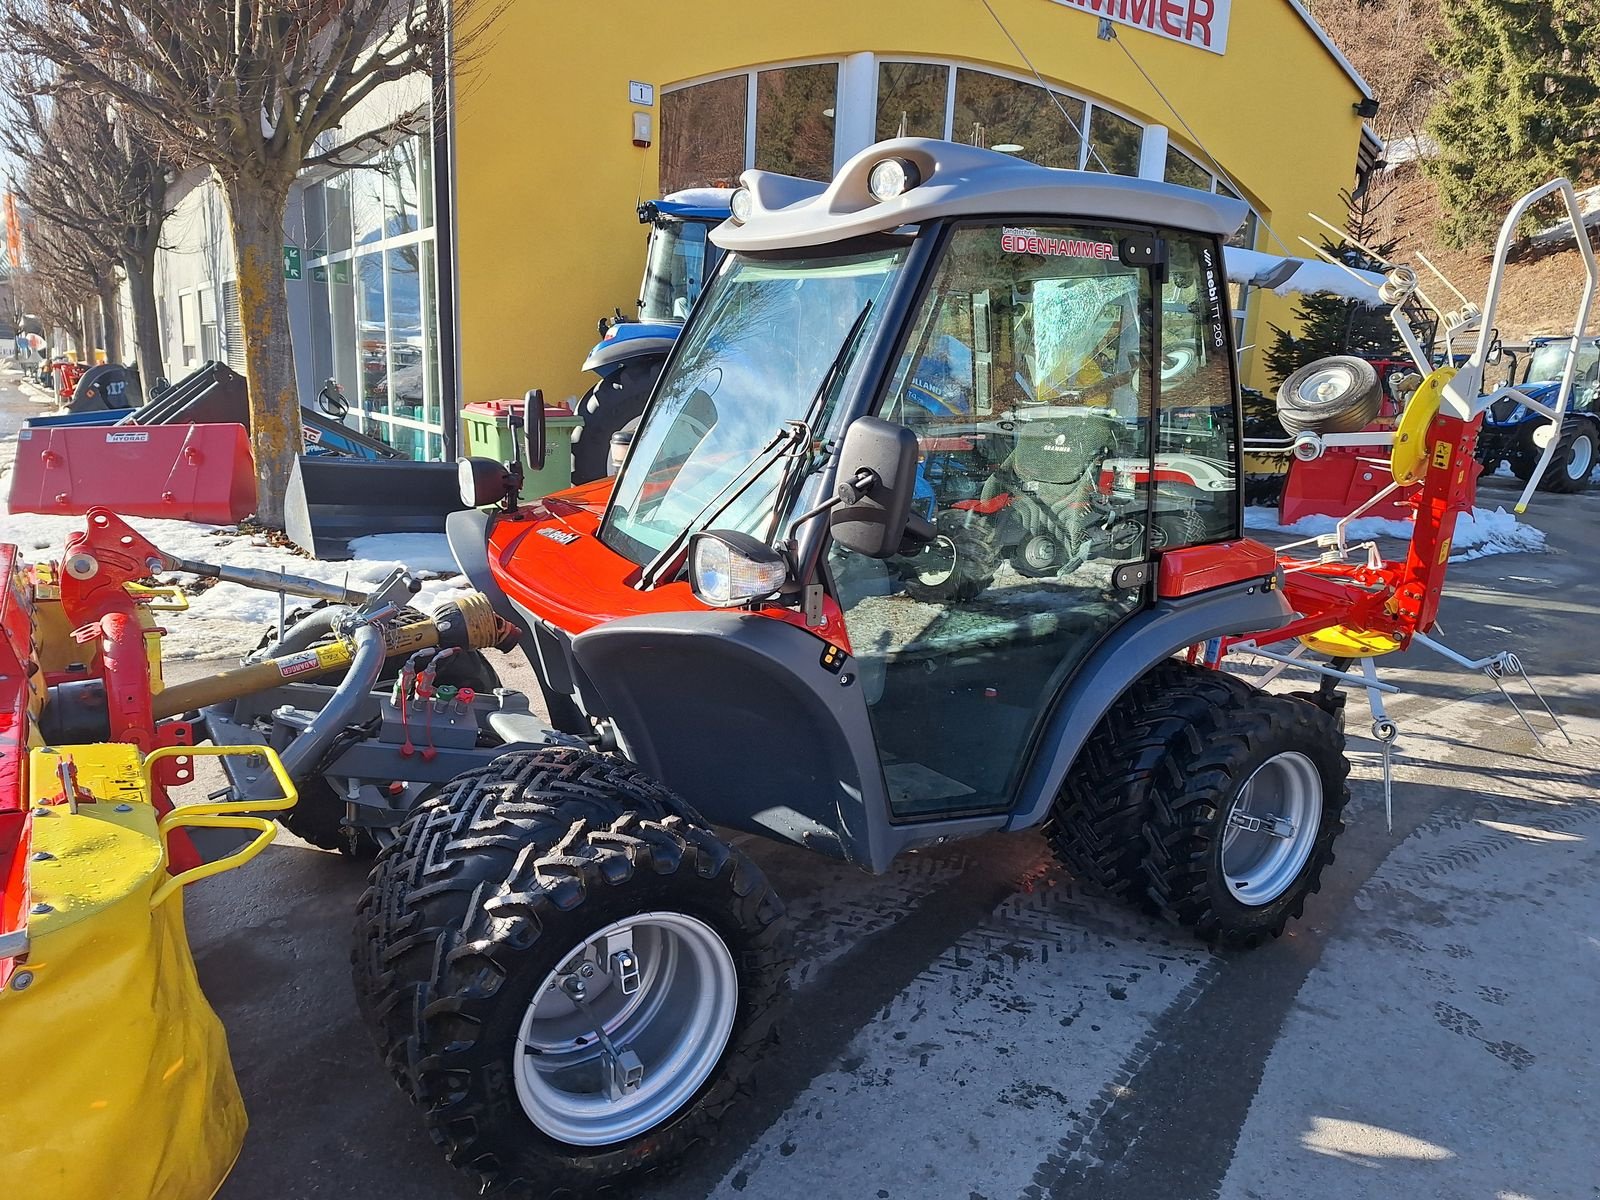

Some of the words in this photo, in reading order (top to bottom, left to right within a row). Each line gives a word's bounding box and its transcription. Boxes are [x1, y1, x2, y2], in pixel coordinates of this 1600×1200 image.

[1001, 234, 1114, 260] EIDENHAMMER
[1206, 270, 1219, 302] aebi
[1211, 303, 1221, 319] TT
[1213, 323, 1224, 348] 206
[283, 661, 310, 675] DANGER
